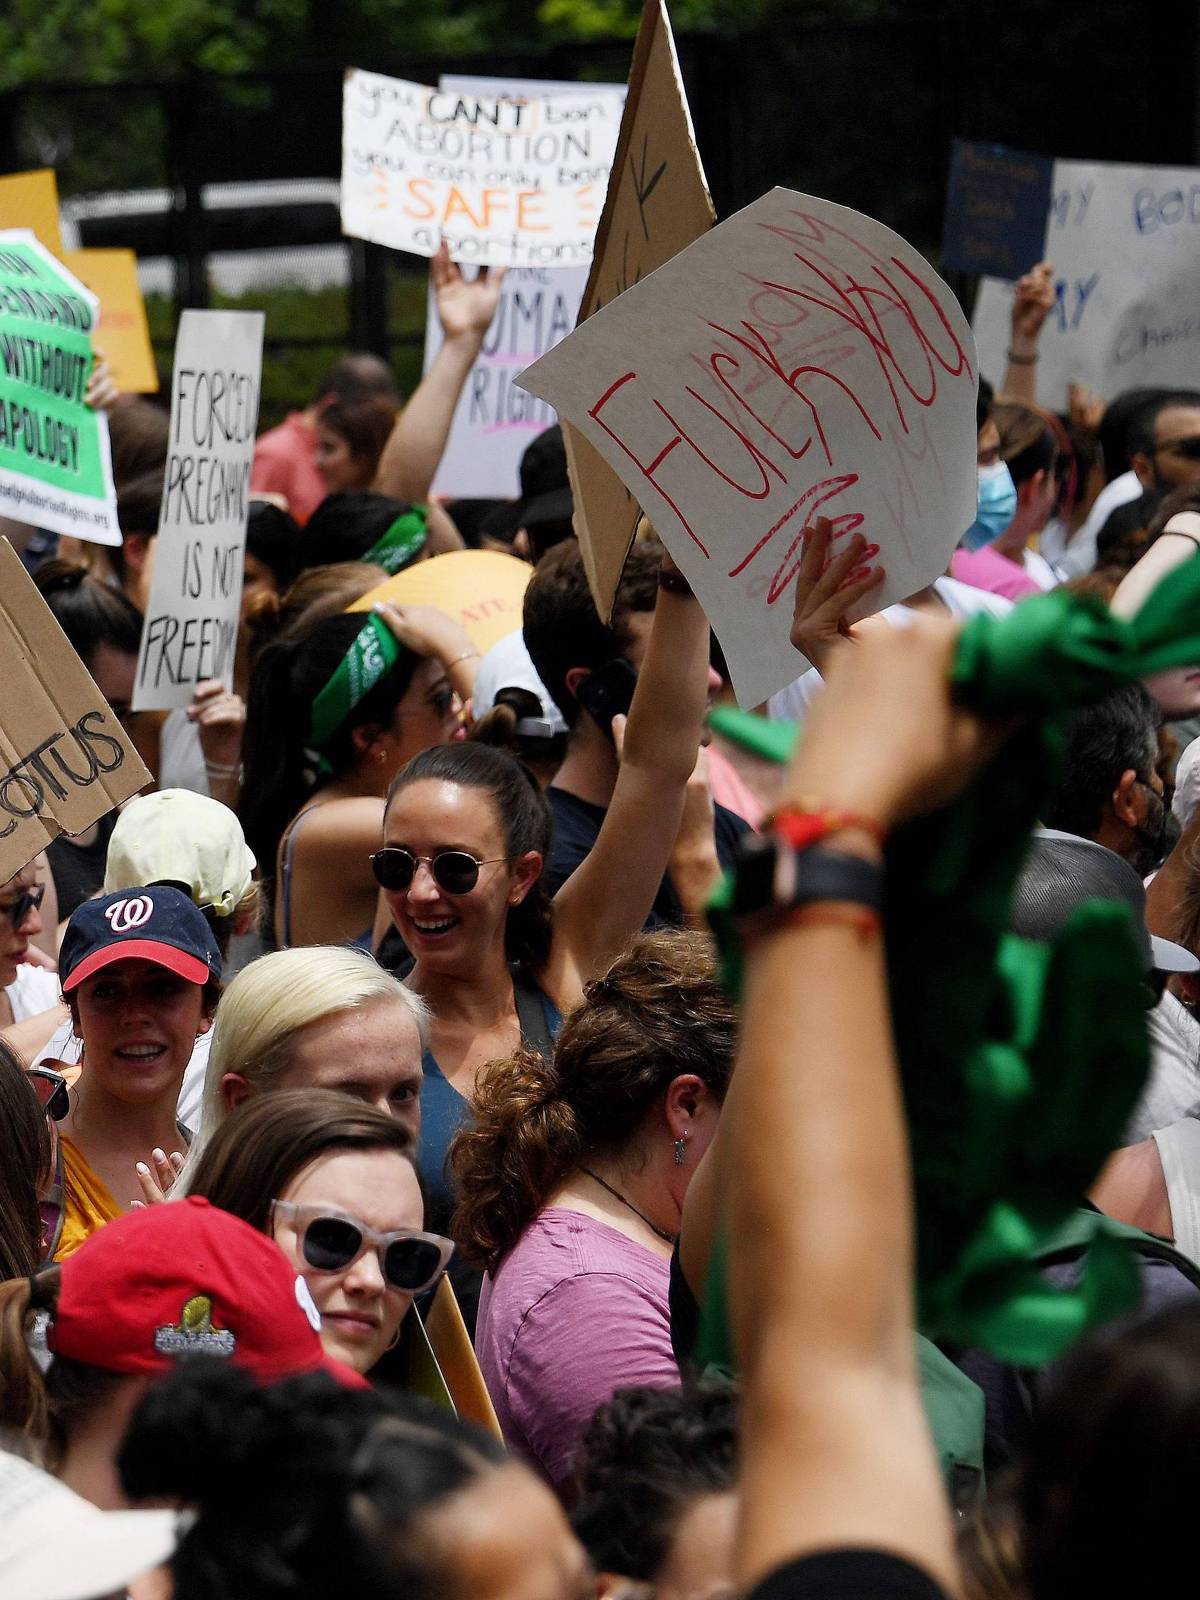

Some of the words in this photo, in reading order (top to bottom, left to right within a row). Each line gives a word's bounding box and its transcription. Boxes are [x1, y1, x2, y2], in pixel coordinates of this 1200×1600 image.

[384, 118, 592, 166] ABORTION
[403, 177, 551, 232] SAFE
[181, 540, 202, 600] IS
